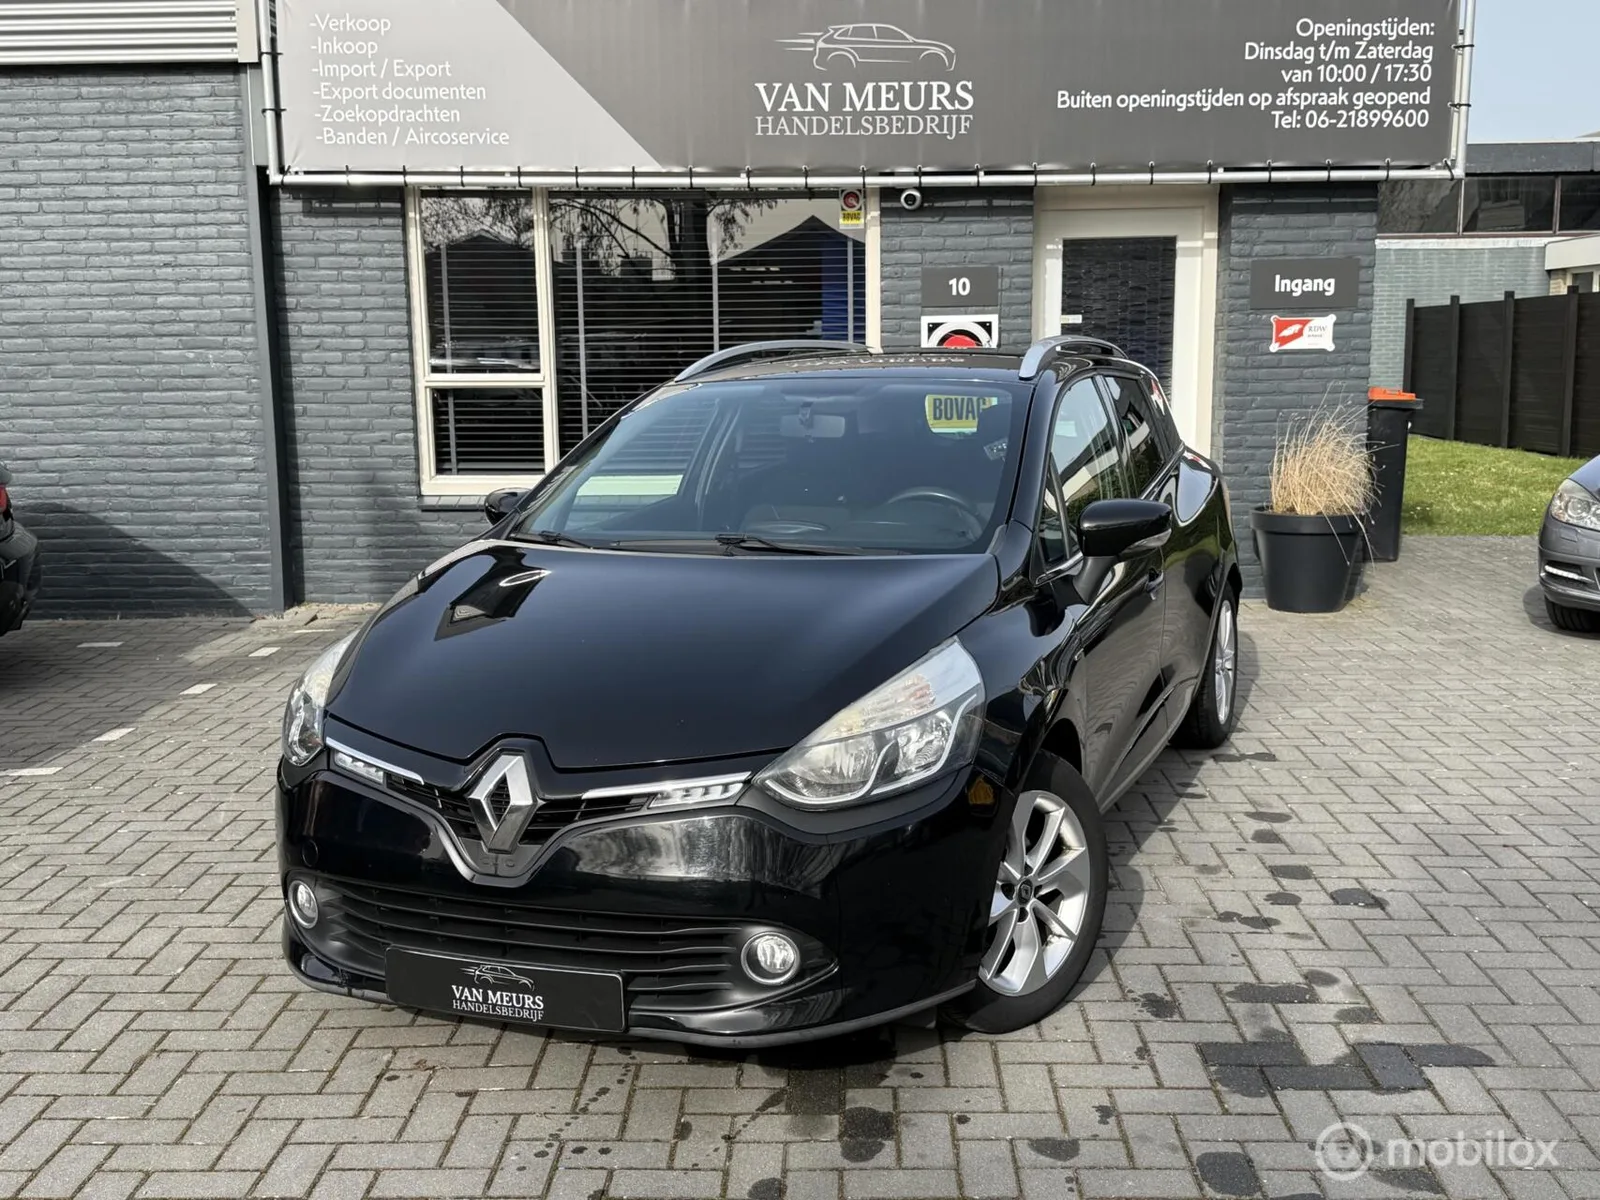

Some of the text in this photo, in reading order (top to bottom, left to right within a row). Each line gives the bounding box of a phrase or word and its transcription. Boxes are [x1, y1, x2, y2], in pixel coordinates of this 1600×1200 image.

[309, 12, 391, 36] -Verkoop
[1296, 17, 1435, 41] Openingstijden:
[310, 36, 378, 58] -Inkoop
[1244, 40, 1433, 64] Dinsdag t/m Zaterdag
[311, 58, 452, 82] -Import / Export
[1281, 63, 1432, 84] van 10:00 / 17:30
[313, 81, 486, 104] -Export documenten
[754, 80, 974, 112] VAN MEURS
[1057, 86, 1431, 112] Buiten openingstijden op afspraak geopend
[314, 104, 460, 126] -Zoekopdrachten
[1271, 109, 1430, 129] Tel: 06-21899600
[315, 126, 510, 146] -Banden / Aircoservice
[755, 114, 974, 140] HANDELSBEDRIJF
[948, 277, 971, 296] 10
[1274, 274, 1336, 297] Ingang
[451, 984, 545, 1010] VAN MEURS
[452, 999, 545, 1022] HANDELSBEDRIJF
